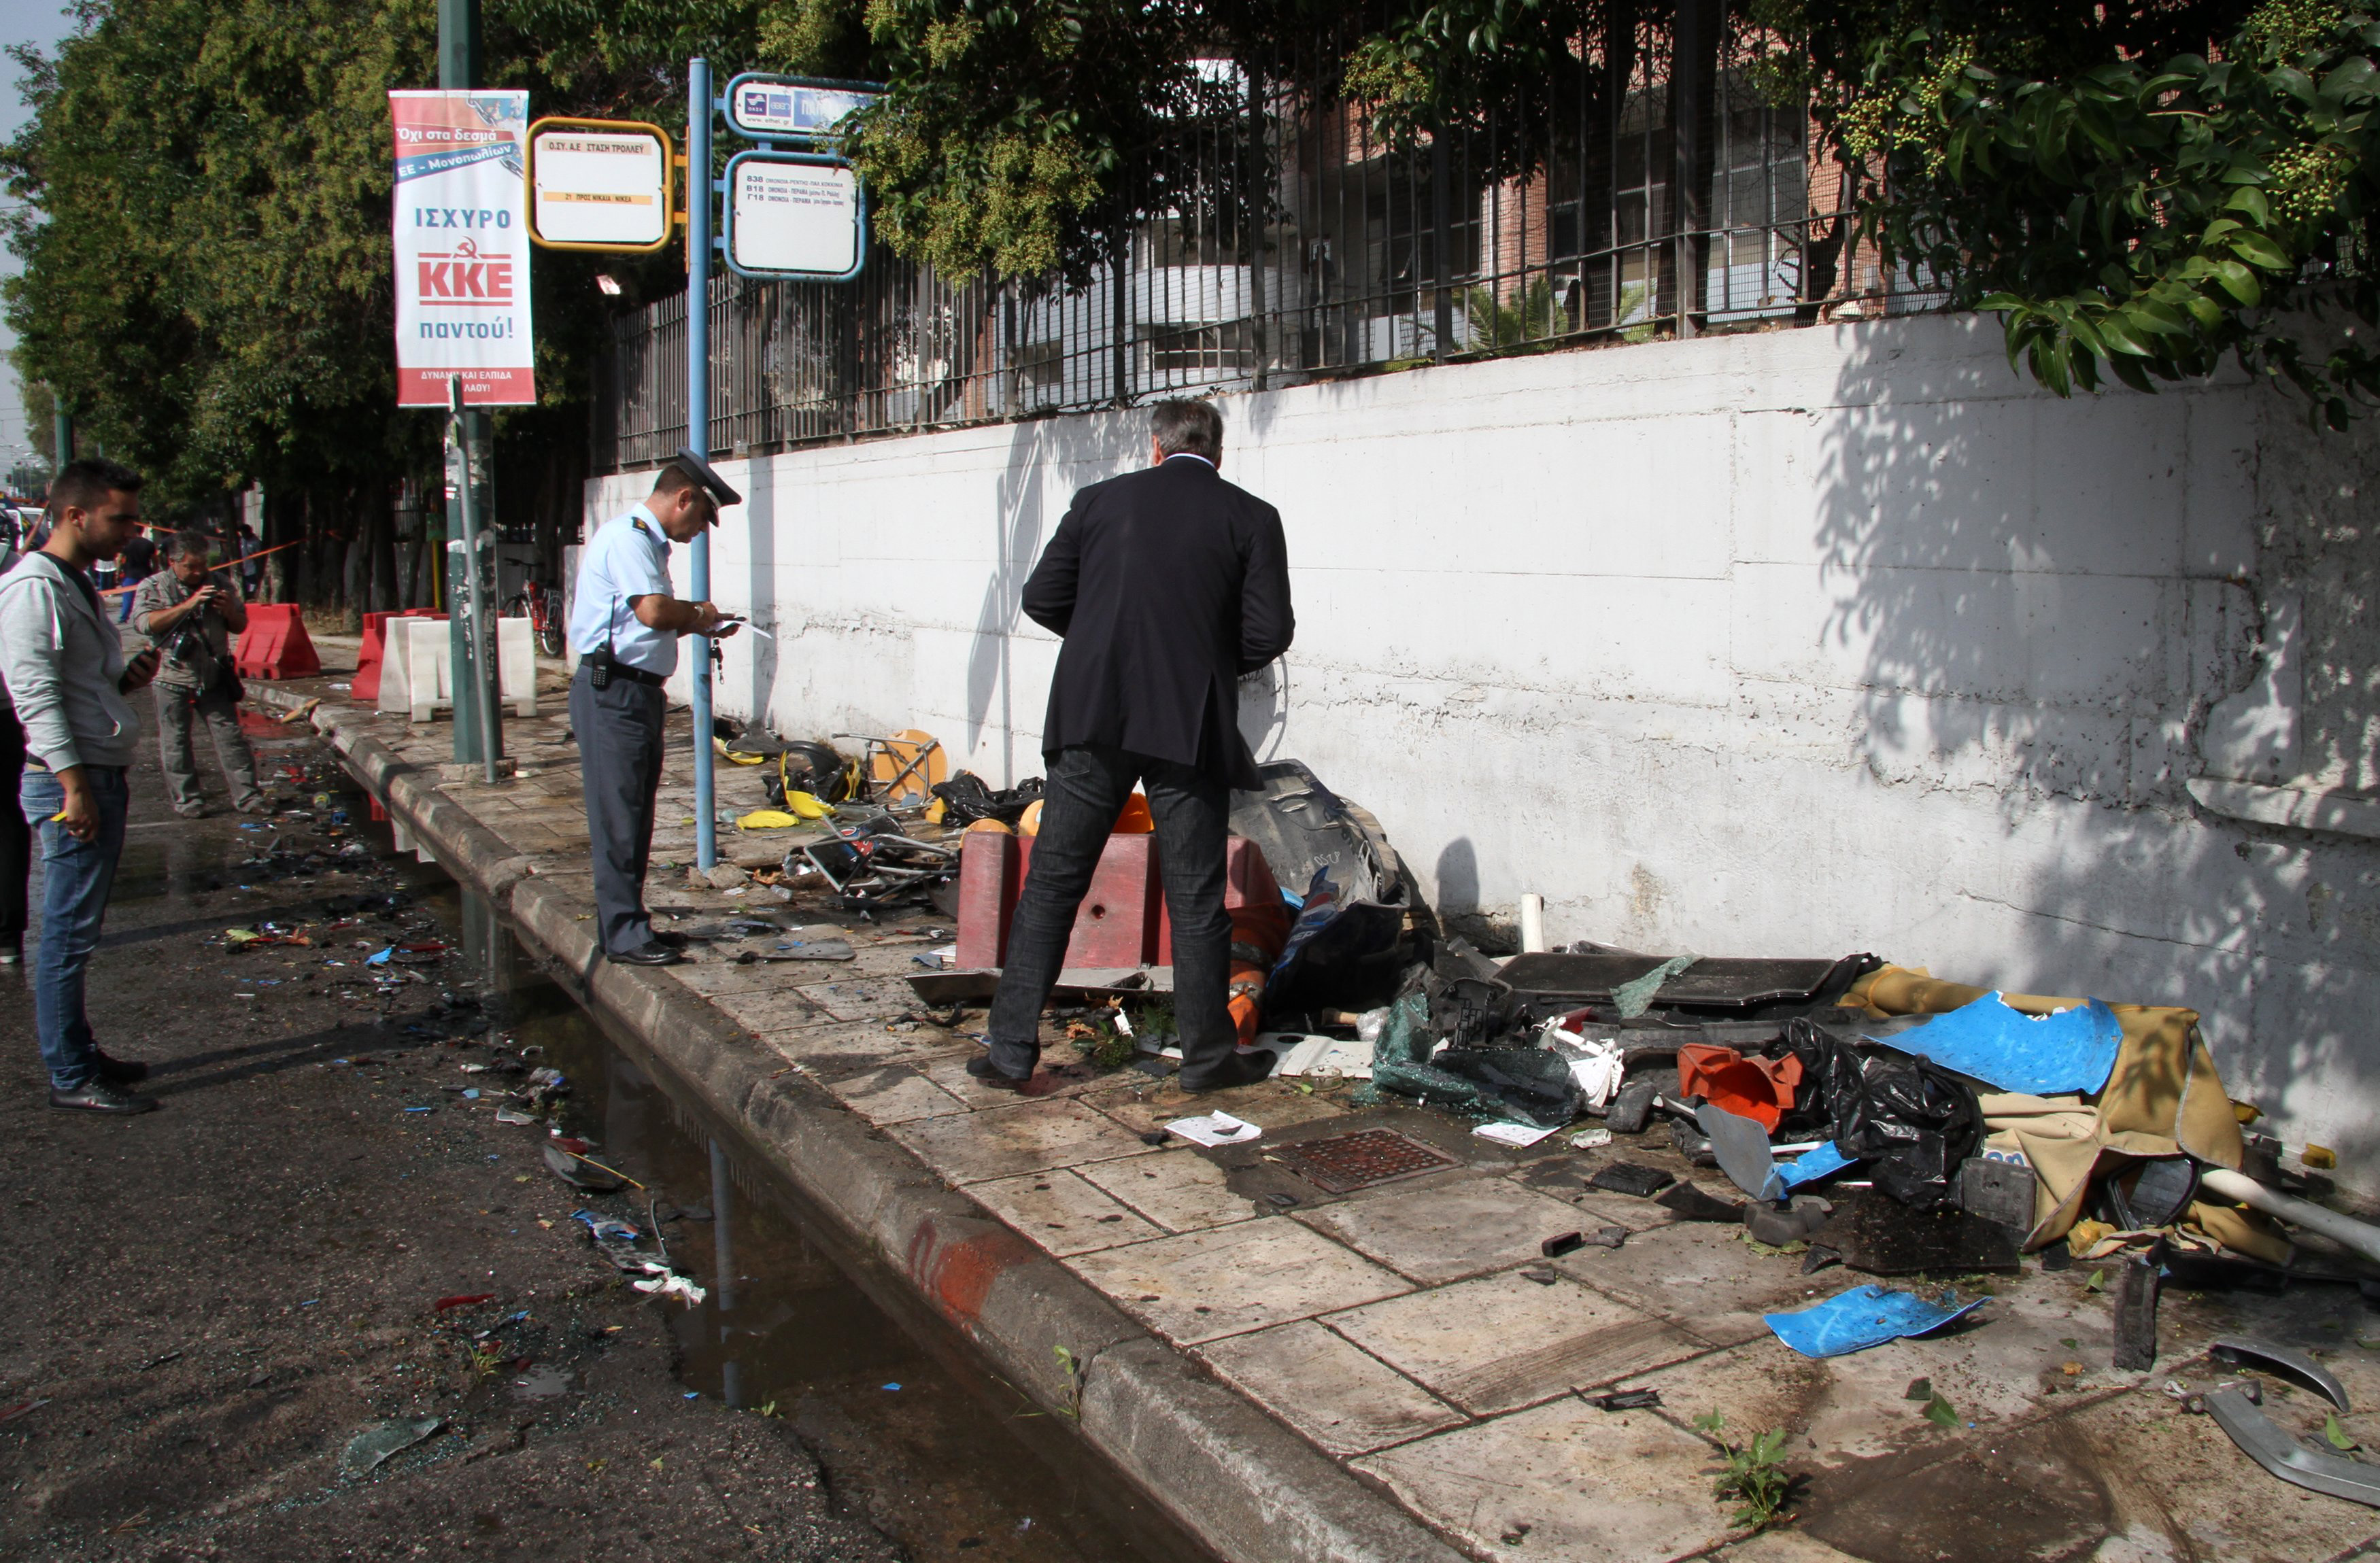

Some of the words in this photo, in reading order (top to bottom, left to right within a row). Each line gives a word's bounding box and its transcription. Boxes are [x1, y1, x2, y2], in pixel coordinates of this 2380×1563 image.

[397, 127, 422, 142] Όχι
[426, 131, 450, 140] στα
[454, 128, 497, 142] δεσμά
[587, 143, 610, 152] ΣΤΑΣΗ
[398, 164, 416, 177] ΕΕ
[428, 144, 511, 170] Μονοπωλίων
[793, 196, 811, 205] ΠΕΡΑΜΑ
[415, 208, 511, 228] ΙΣΧΥΡΟ
[418, 262, 513, 297] ΚΚΕ
[420, 316, 513, 339] παντού!
[462, 371, 477, 379] ΚΑΙ
[480, 371, 512, 379] ΕΛΠΙΔΑ
[464, 383, 490, 392] ΛΑΟΥ!
